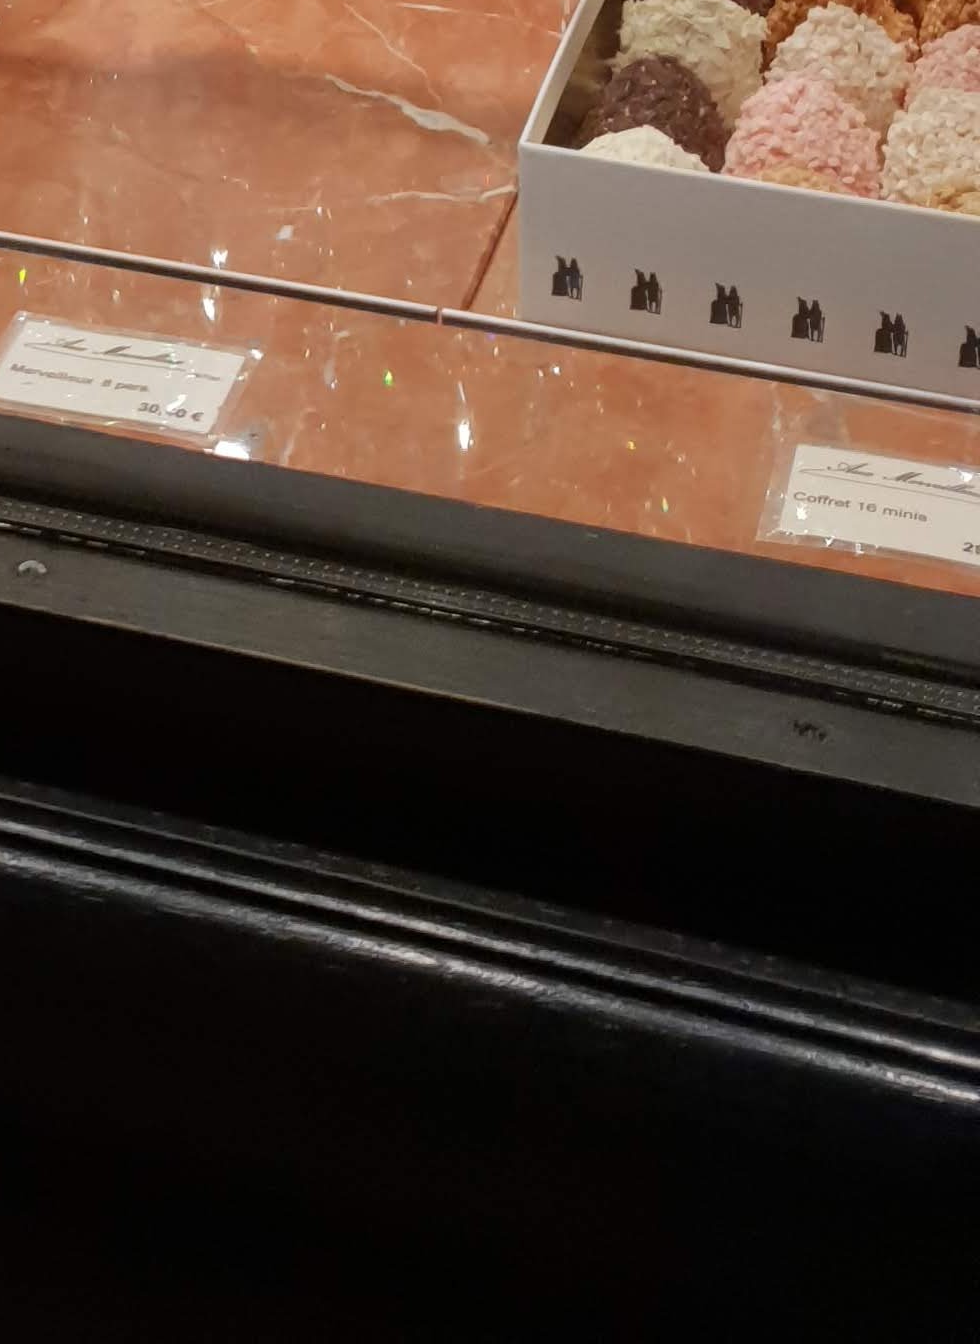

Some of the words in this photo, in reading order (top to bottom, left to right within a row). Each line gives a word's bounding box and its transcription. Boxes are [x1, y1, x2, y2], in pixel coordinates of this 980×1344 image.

[191, 410, 205, 422] €
[793, 490, 851, 510] Coffret
[858, 501, 878, 514] 16
[882, 506, 928, 524] minis
